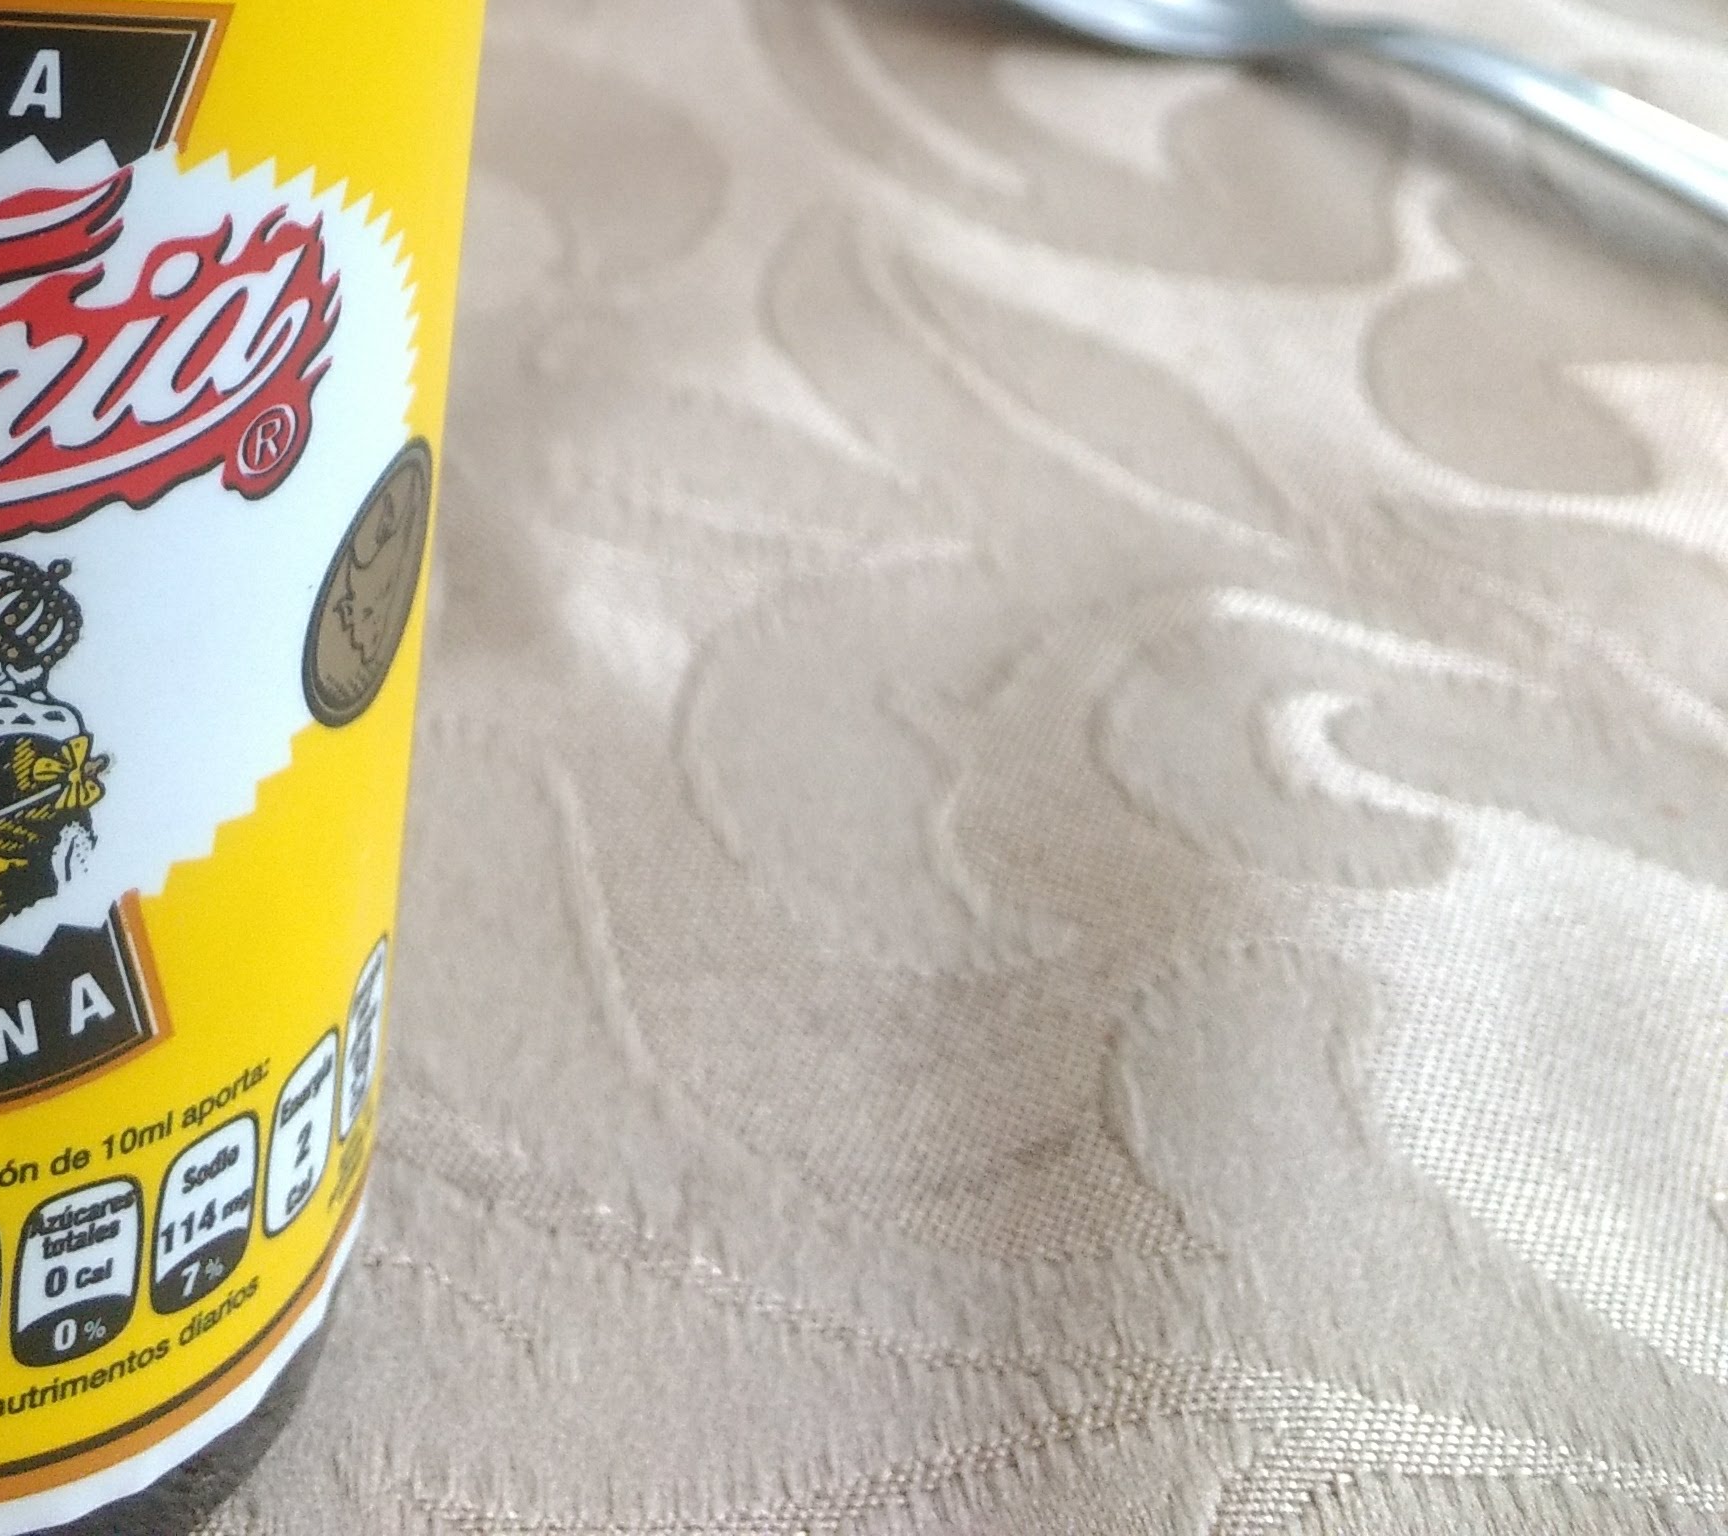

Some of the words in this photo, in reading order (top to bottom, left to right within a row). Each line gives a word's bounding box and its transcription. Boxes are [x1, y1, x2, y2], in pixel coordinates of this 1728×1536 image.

[51, 1146, 90, 1175] de
[103, 1114, 172, 1160] 10ml
[181, 1058, 271, 1126] aporta:
[294, 1120, 313, 1168] 2
[181, 1144, 239, 1194] Sodio
[29, 1189, 136, 1238] Azúcares
[161, 1198, 216, 1253] 114
[42, 1219, 121, 1260] totales
[45, 1265, 68, 1297] 0
[75, 1258, 113, 1289] Cal
[181, 1261, 200, 1297] 7
[53, 1319, 76, 1351] 0
[84, 1318, 106, 1341] %
[179, 1275, 261, 1348] diarios
